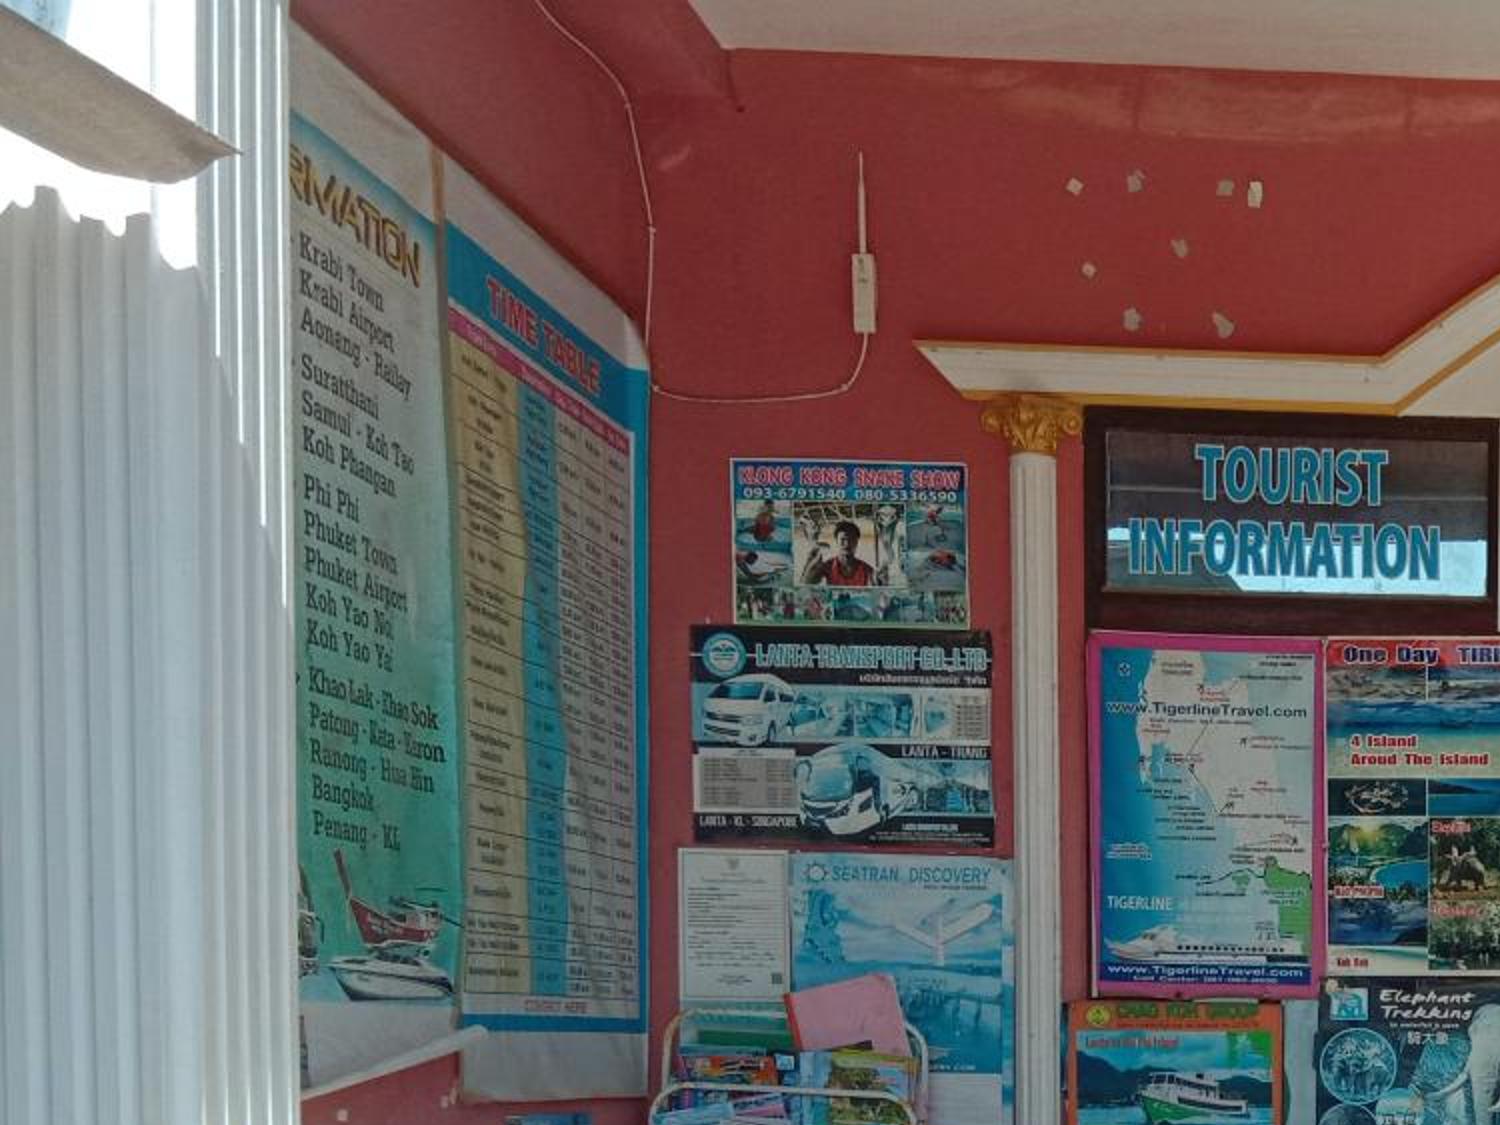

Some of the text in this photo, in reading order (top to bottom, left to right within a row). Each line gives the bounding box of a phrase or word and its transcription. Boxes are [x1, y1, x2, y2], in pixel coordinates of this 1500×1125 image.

[299, 235, 385, 313] Krabi Town
[299, 268, 395, 354] Krabi Airport
[301, 305, 361, 369] Aonang
[486, 277, 601, 398] TIME TABLE
[300, 353, 380, 421] Suratthani
[301, 389, 415, 476] Samui Koh Tao
[302, 425, 398, 499] Koh Phangan
[1194, 443, 1389, 508] TOURIST
[303, 473, 360, 525] Phi Phi
[303, 508, 398, 577] Phuket Town
[1127, 517, 1441, 581] INFORMATION
[303, 544, 409, 614] Phuket Airport
[305, 581, 338, 618] Koh
[342, 595, 369, 629] Yao
[306, 617, 339, 652] Koh
[342, 631, 371, 665] Yao
[1343, 645, 1387, 663] One
[1397, 646, 1439, 666] Day
[309, 701, 360, 746] Patong
[411, 701, 439, 731] Sok
[1106, 701, 1308, 719] www.TigerlineTravel.com
[310, 737, 368, 783] Ranong
[1350, 753, 1488, 767] Aroud The Island
[1351, 734, 1417, 748] 4 Island
[311, 773, 374, 812] Bangkok
[312, 809, 368, 851] Penang
[831, 865, 991, 884] SEATRAN DISCOVERY
[1107, 895, 1174, 911] TIGERLINE
[1107, 965, 1304, 978] www.TigerlineTravel.com
[1380, 988, 1476, 1005] Elephant
[1380, 1005, 1473, 1021] Trekking
